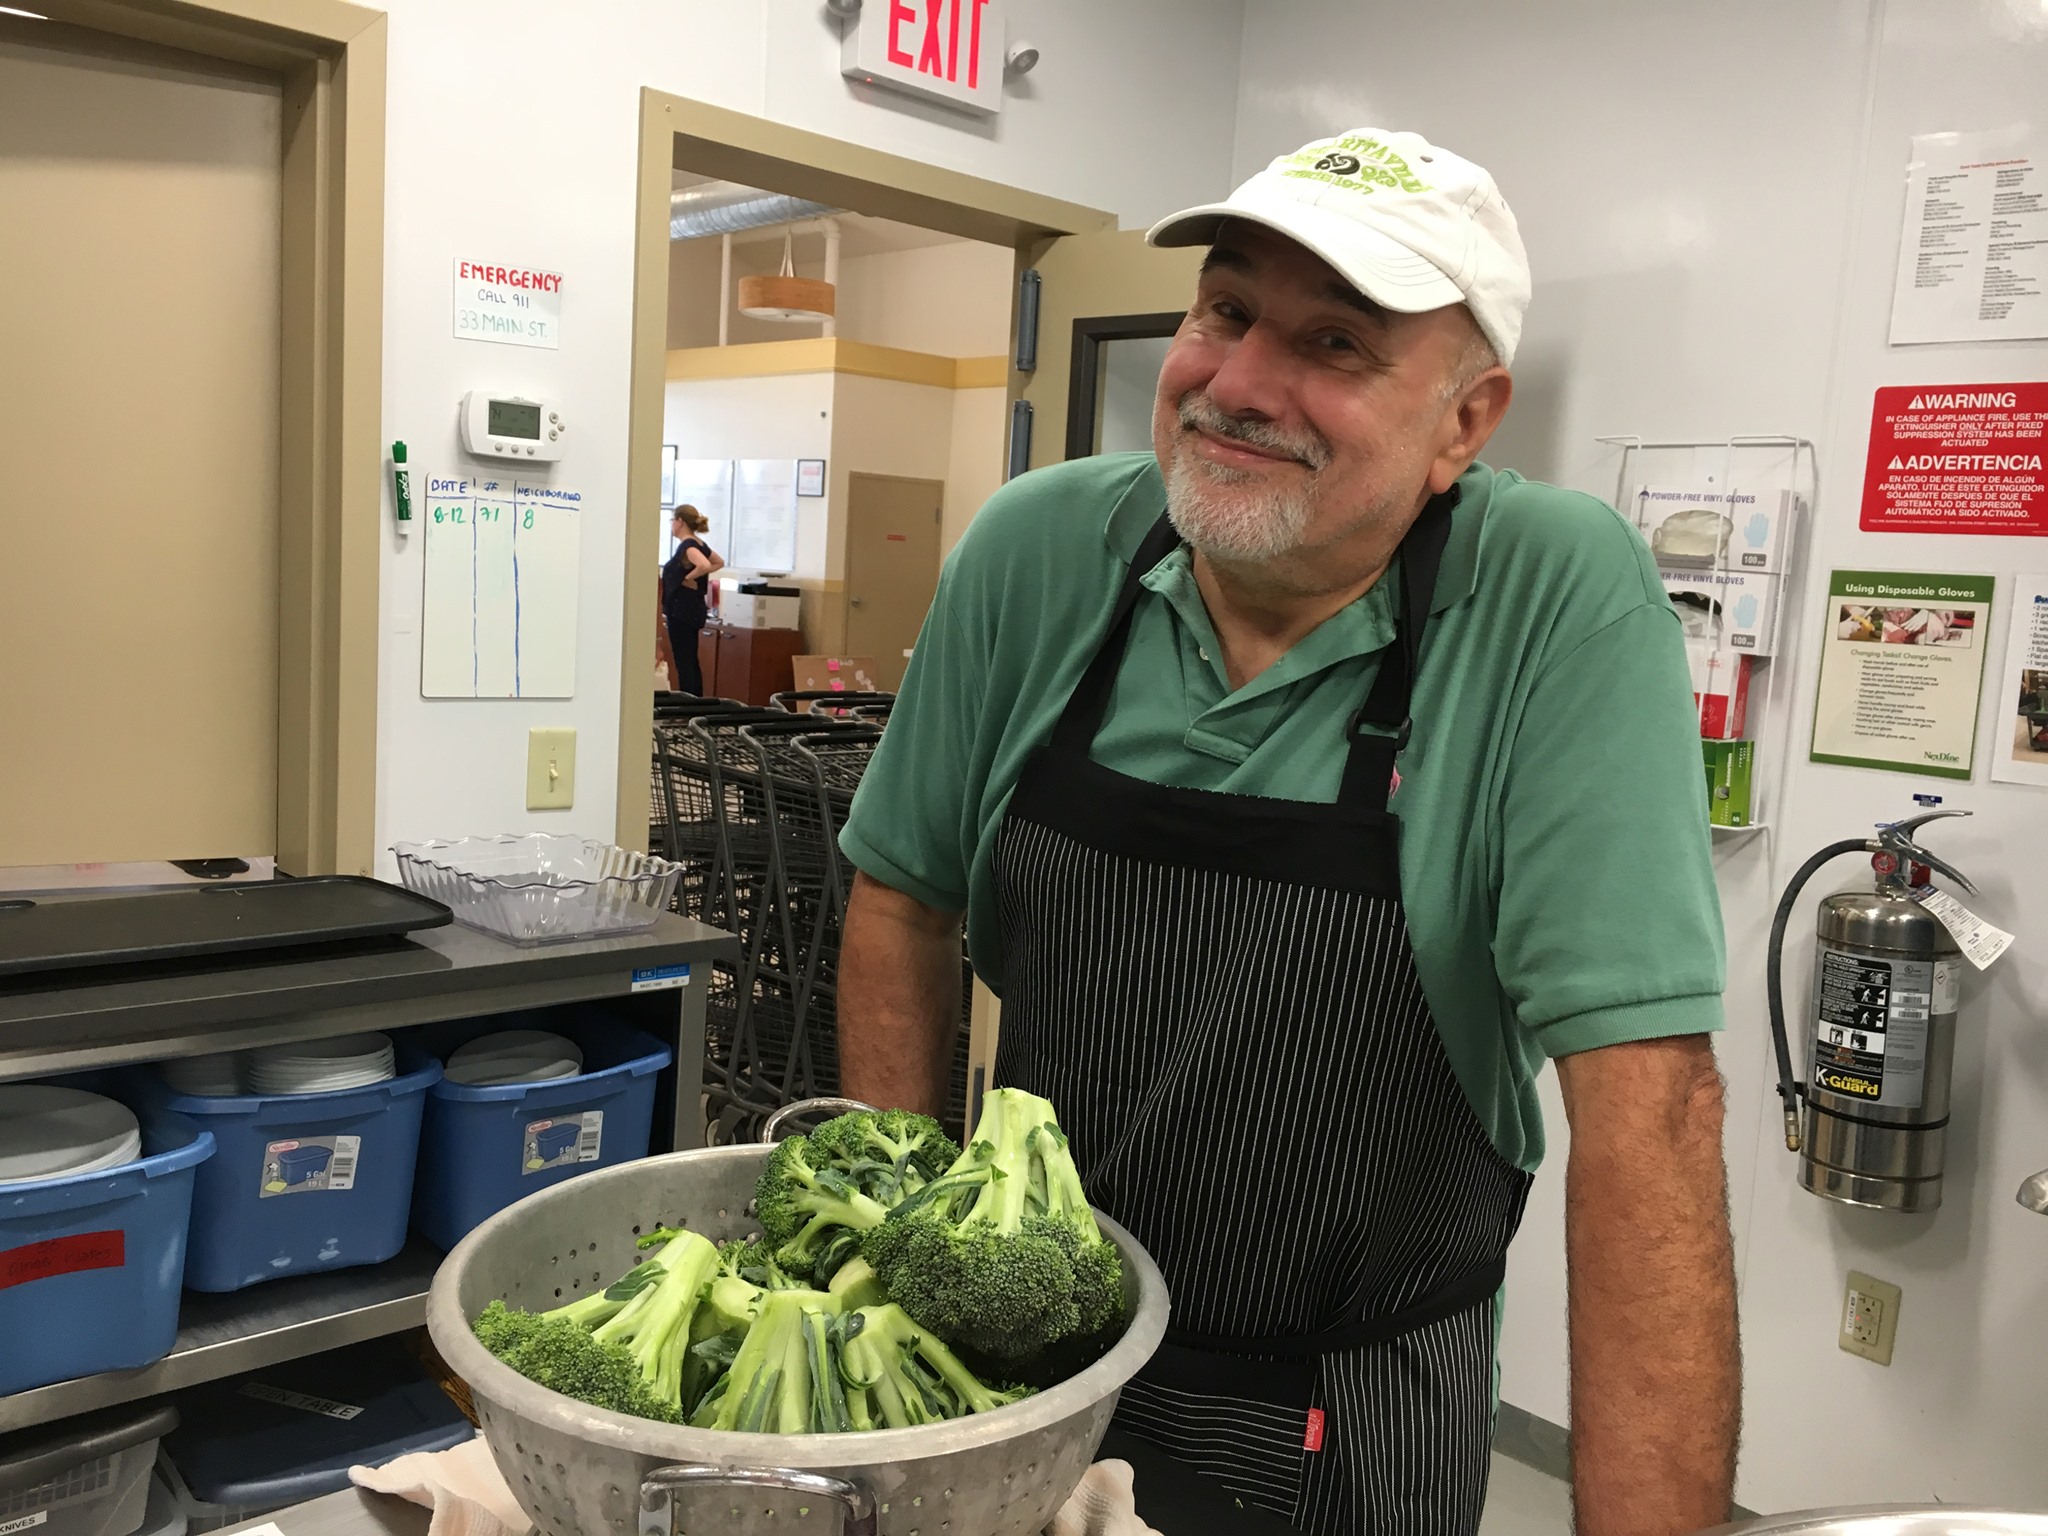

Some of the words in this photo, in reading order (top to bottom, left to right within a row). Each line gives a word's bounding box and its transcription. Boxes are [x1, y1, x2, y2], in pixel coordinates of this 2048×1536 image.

[887, 0, 989, 89] EXIT
[460, 262, 562, 293] EMERGENCY
[477, 288, 506, 304] CALL
[513, 294, 529, 309] 911
[460, 309, 479, 330] 33
[482, 313, 523, 334] MAIN
[528, 320, 548, 338] ST.
[1924, 392, 2017, 409] WARNING
[1885, 415, 1894, 423] IN
[1936, 414, 1985, 422] APPLIANCE
[1893, 431, 1956, 439] SUPPRESSION
[1956, 430, 1993, 438] SYSTEM
[1941, 439, 1989, 447] ACTUATED
[1905, 455, 2042, 470] ADVERTENCIA
[431, 480, 468, 494] DATE
[1922, 484, 1956, 492] UTILICE
[1957, 484, 1980, 492] ESTE
[1651, 492, 1702, 502] POWDER-FREE
[1726, 494, 1756, 504] GLOVES
[2021, 493, 2033, 501] EL
[1934, 500, 1953, 508] FIJO
[523, 508, 534, 529] 8
[1958, 509, 1980, 517] SIDO
[1744, 555, 1757, 564] 100
[1660, 572, 1692, 582] ER-FREE
[1716, 576, 1745, 585] GLOVES
[1845, 584, 1874, 595] Using
[1878, 585, 1935, 596] Disposable
[1938, 587, 1975, 598] Gloves
[1734, 636, 1747, 645] 100
[1903, 652, 1928, 661] Change
[1924, 751, 1960, 763] NexDine
[298, 1397, 356, 1417] TABLE
